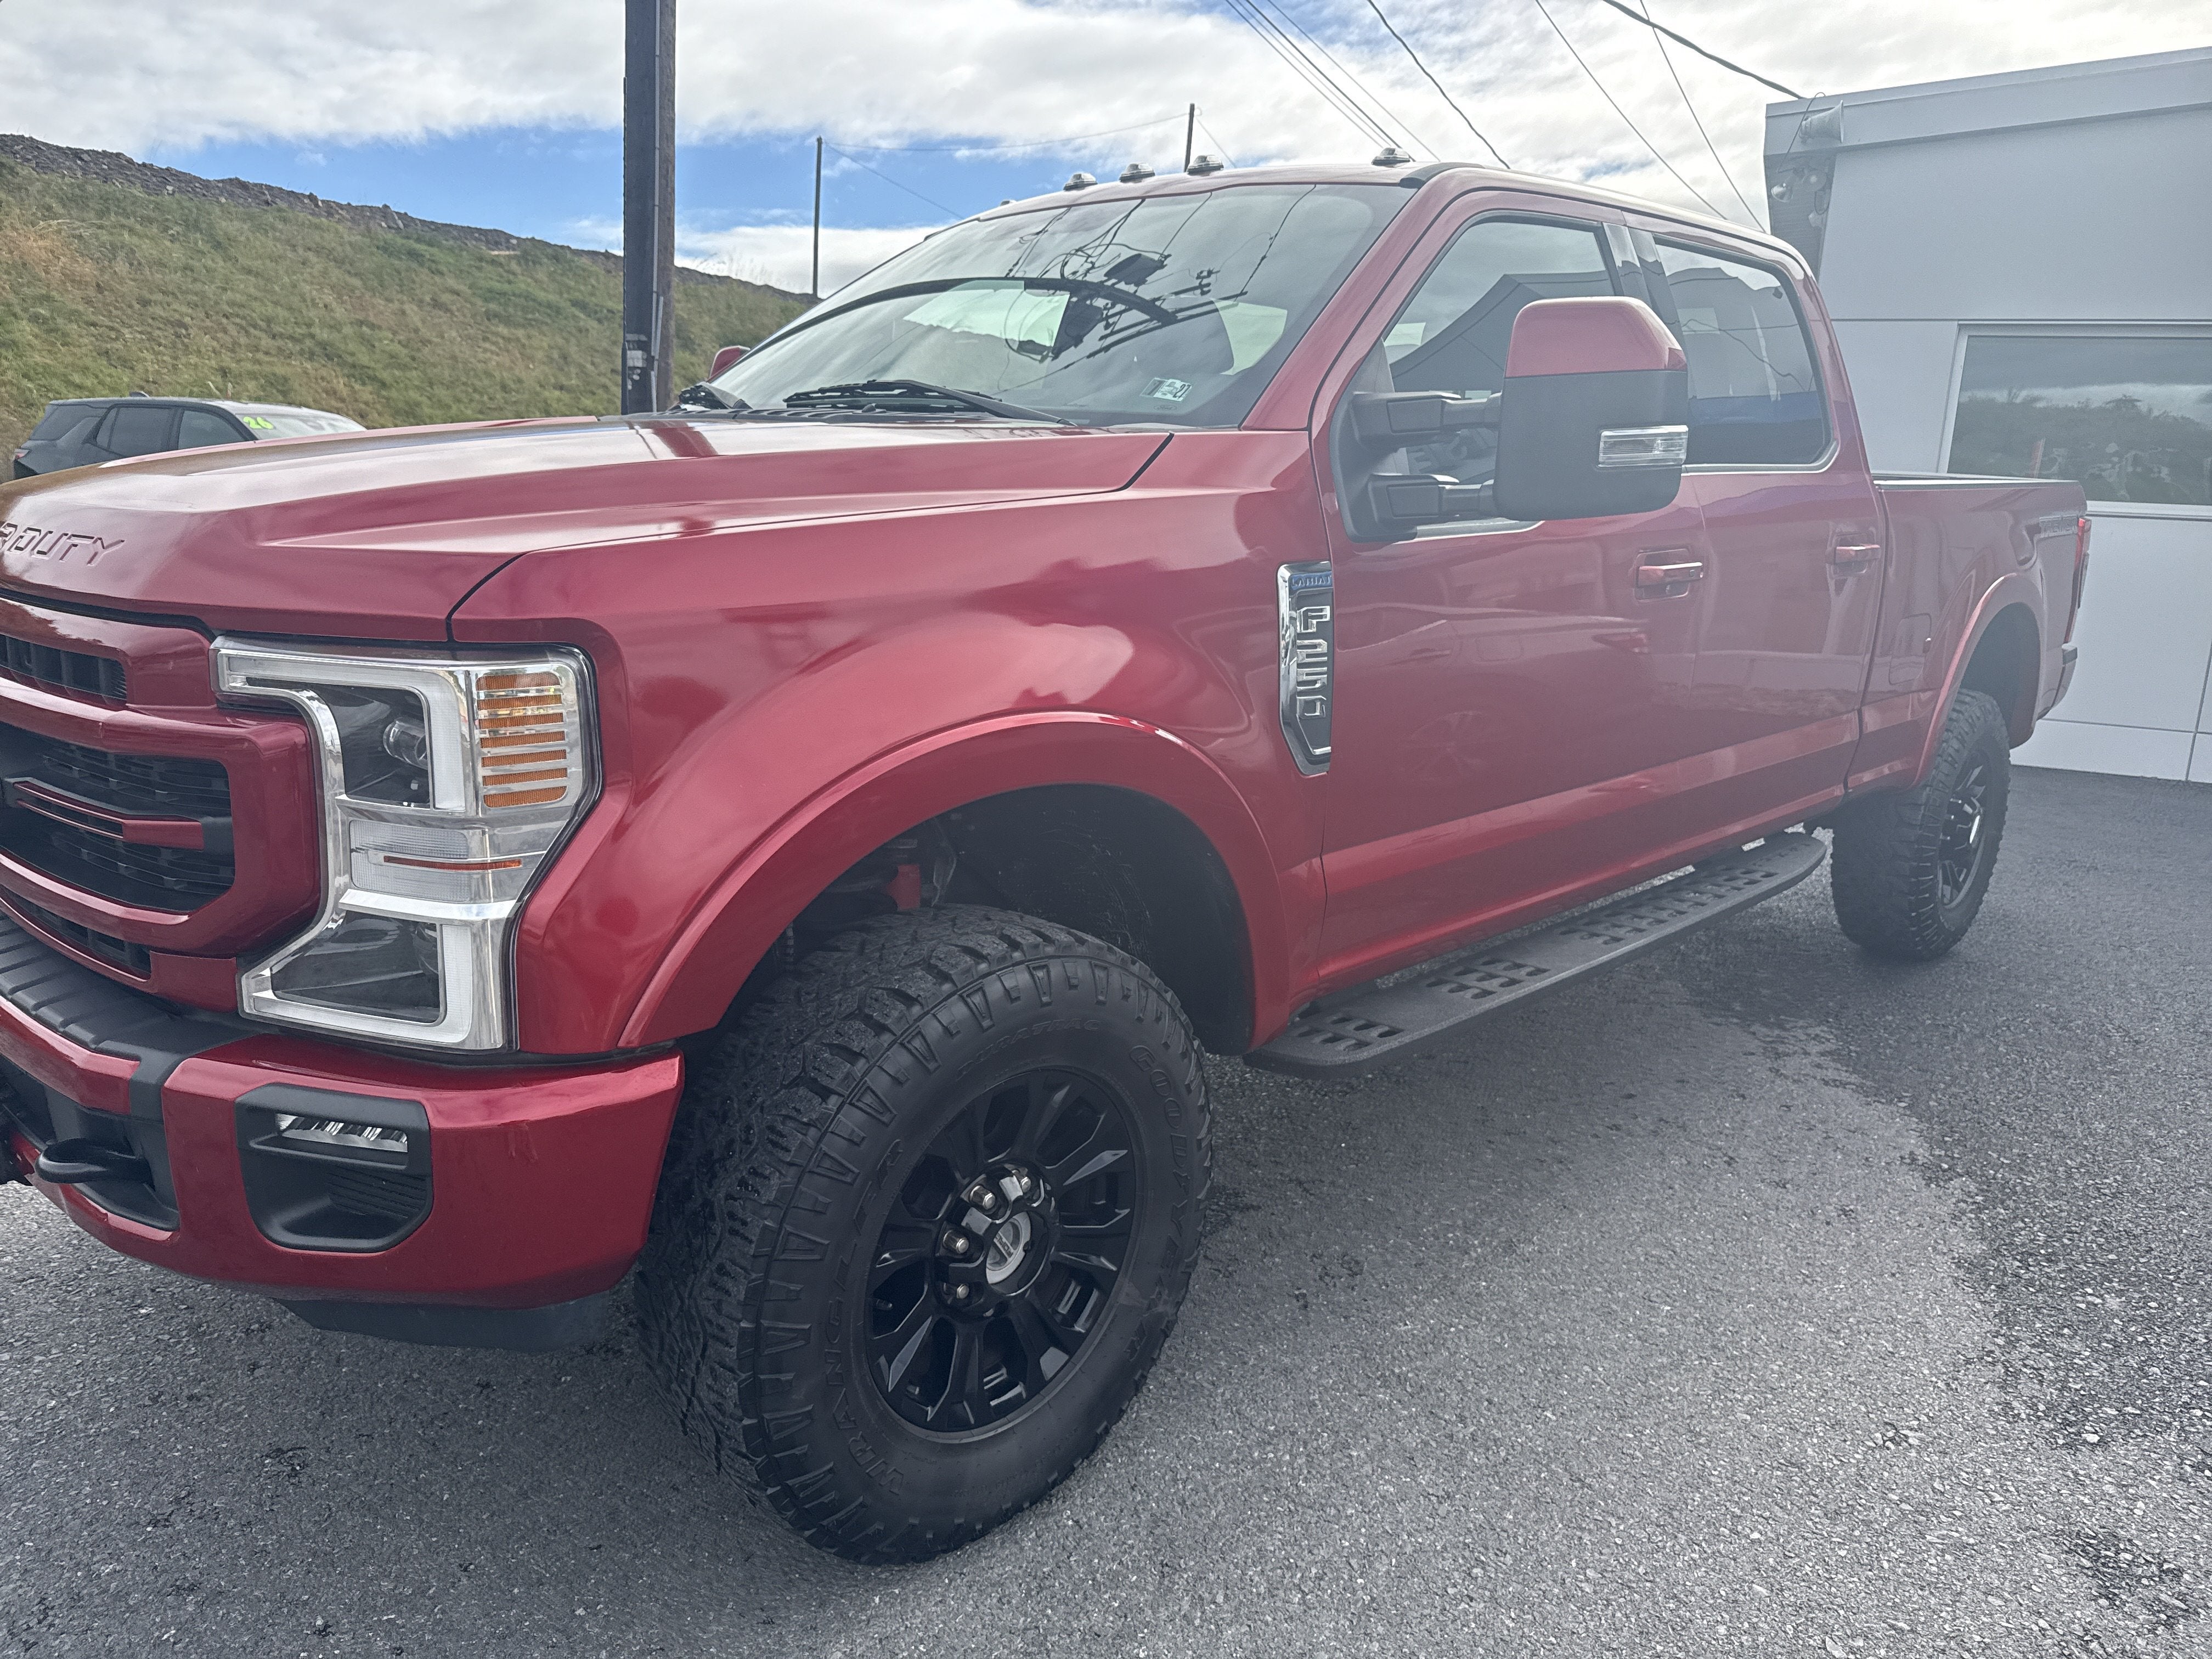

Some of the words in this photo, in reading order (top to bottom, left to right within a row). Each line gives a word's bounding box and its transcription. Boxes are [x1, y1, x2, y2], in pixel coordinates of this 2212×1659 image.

[1172, 383, 1192, 398] 27
[243, 416, 274, 429] 26
[7, 527, 125, 566] DUTY
[824, 1138, 905, 1496] WRANGLER
